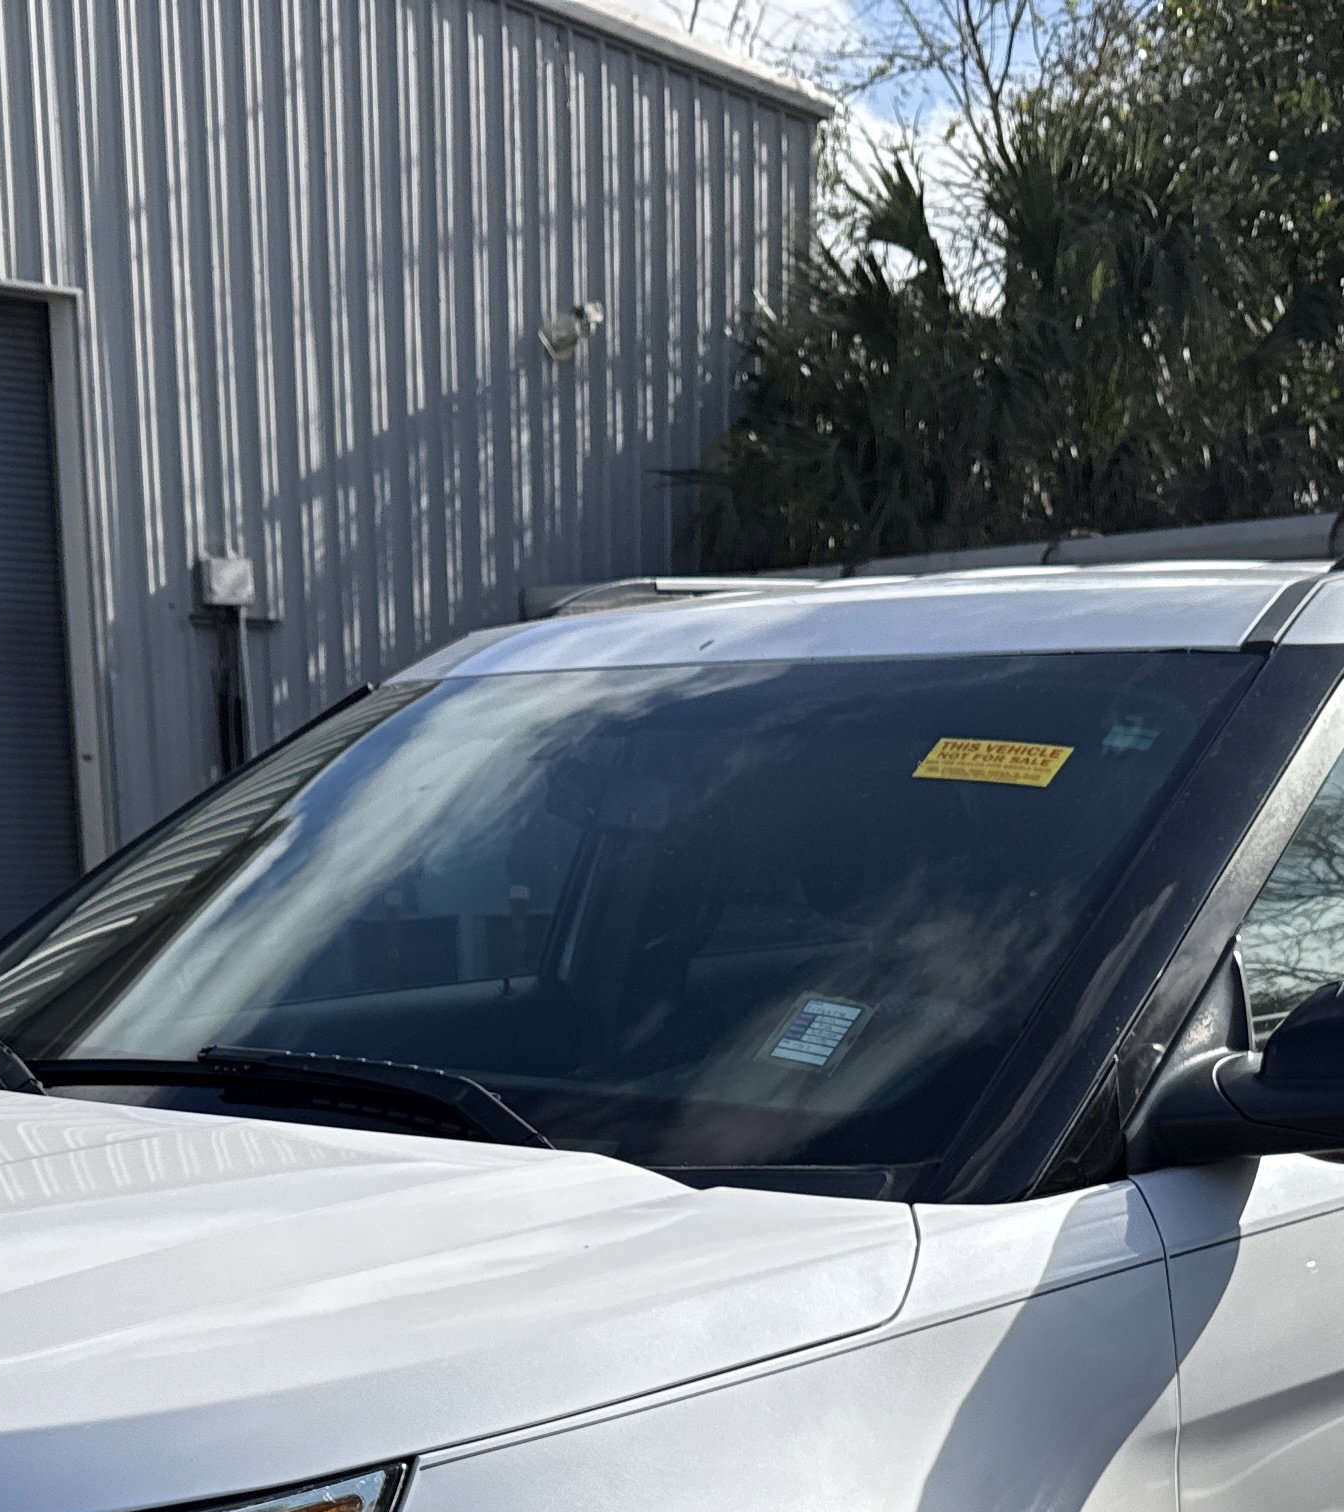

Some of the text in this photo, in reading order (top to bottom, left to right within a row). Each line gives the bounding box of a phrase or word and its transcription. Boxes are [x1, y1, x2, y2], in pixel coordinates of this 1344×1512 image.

[942, 741, 1064, 759] THIS VEHICLE
[937, 751, 1053, 766] NOT FOR SALE
